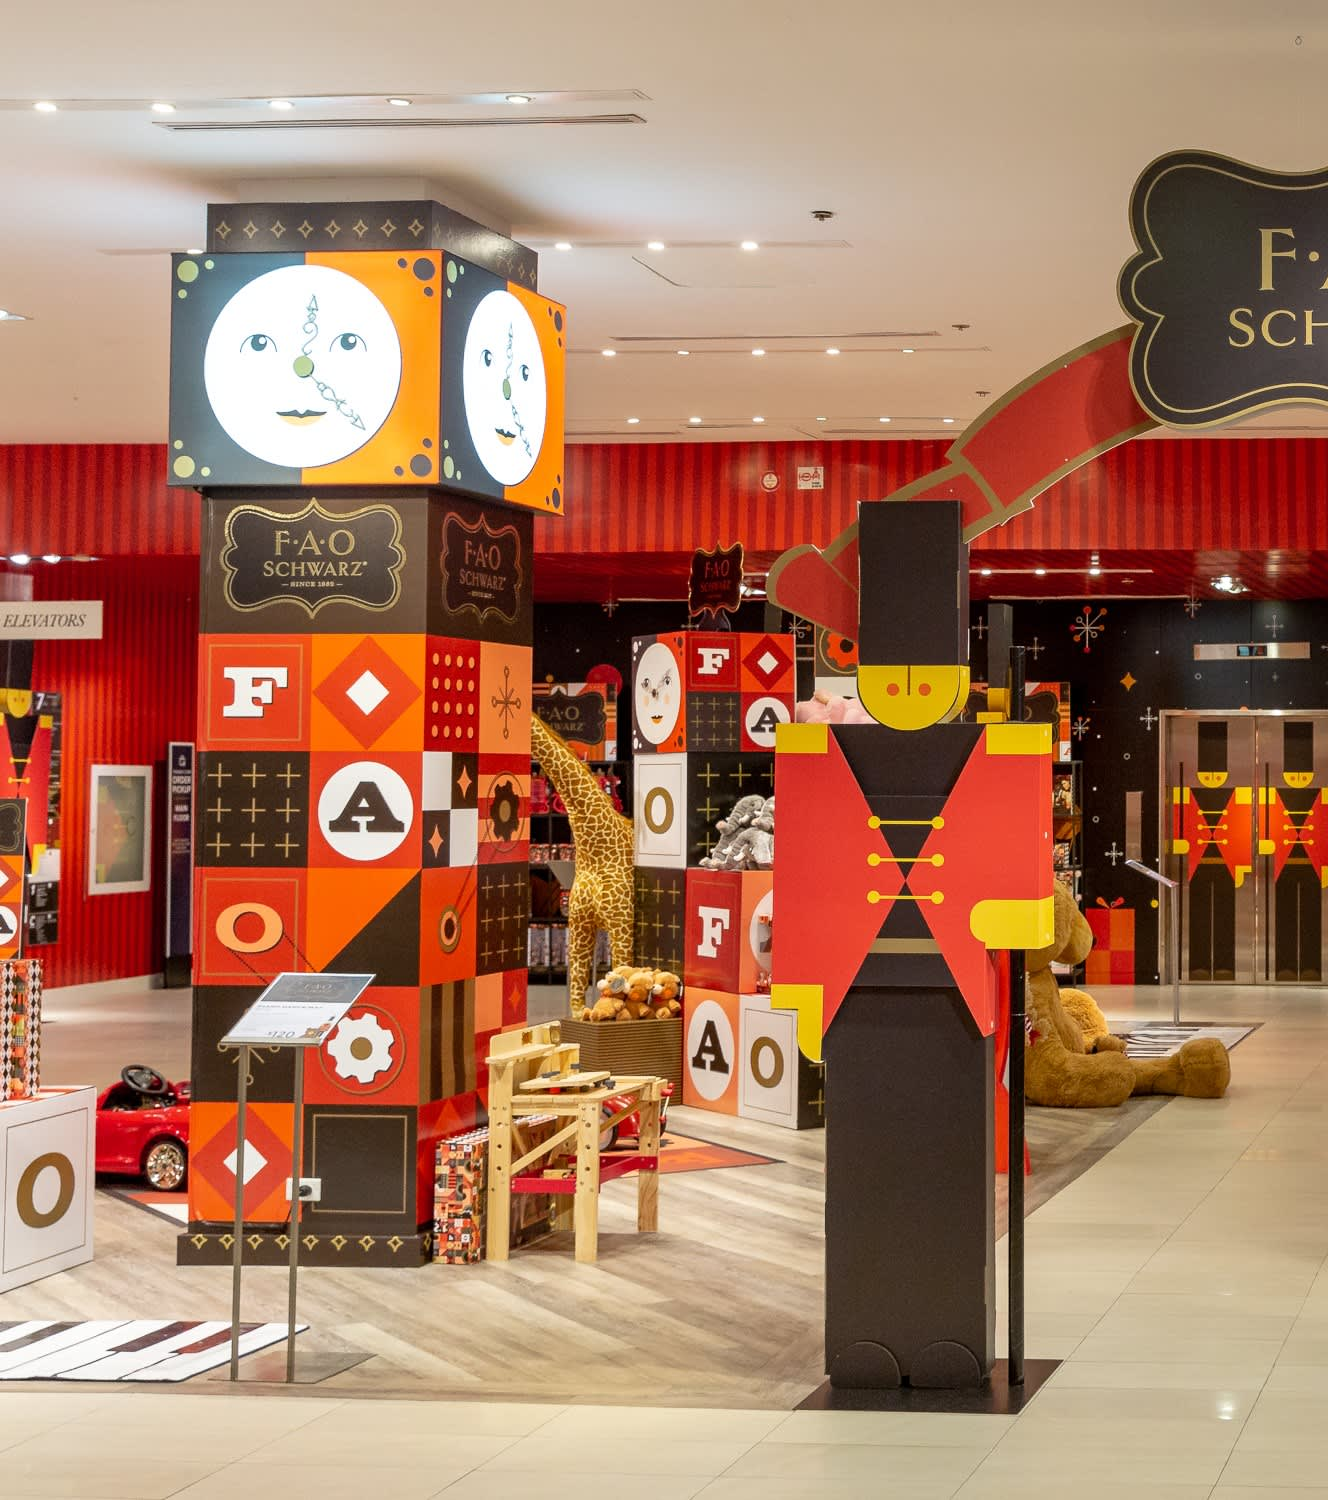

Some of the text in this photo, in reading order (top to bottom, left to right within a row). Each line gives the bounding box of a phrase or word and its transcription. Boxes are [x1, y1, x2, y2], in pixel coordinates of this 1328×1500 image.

[3, 613, 87, 628] ELEVATORS
[698, 648, 729, 675] F
[223, 667, 288, 718] F
[750, 706, 781, 734] A
[329, 781, 404, 833] A
[697, 906, 730, 958] F
[692, 1020, 729, 1075] A
